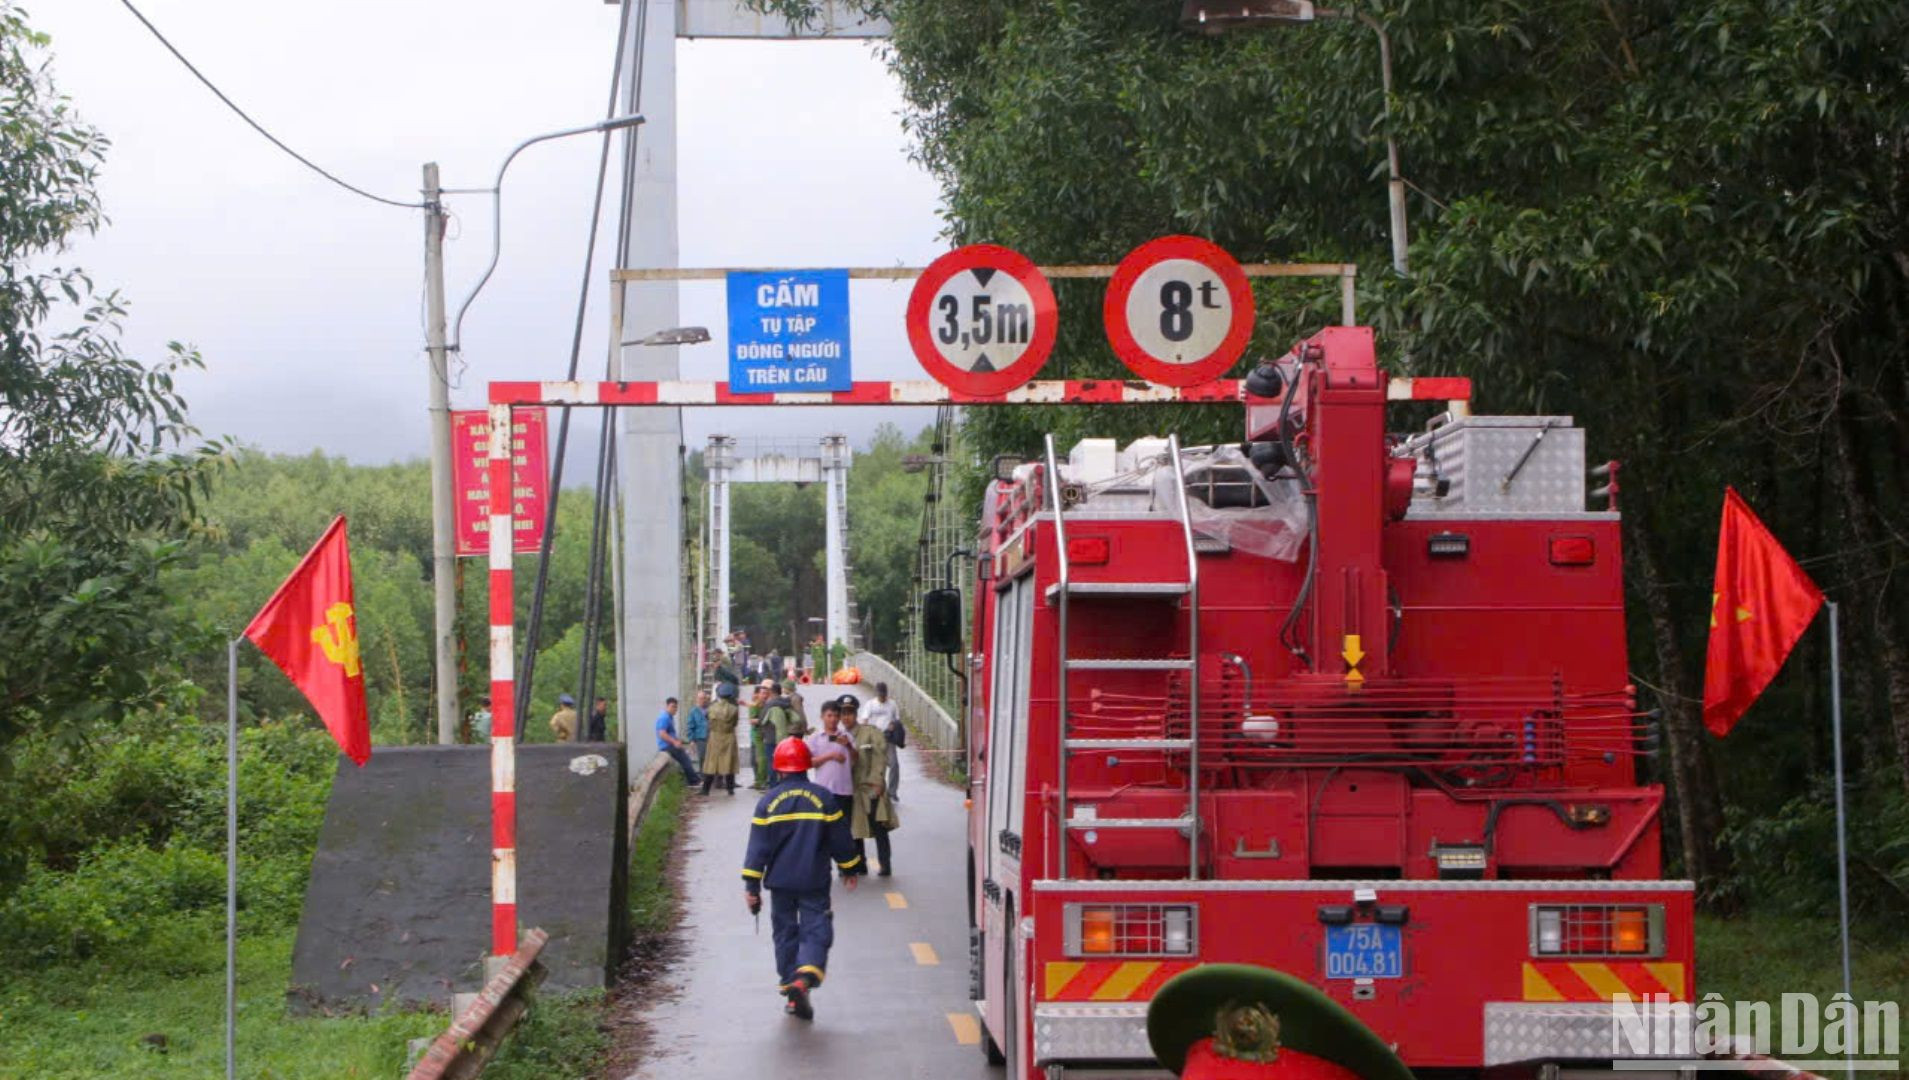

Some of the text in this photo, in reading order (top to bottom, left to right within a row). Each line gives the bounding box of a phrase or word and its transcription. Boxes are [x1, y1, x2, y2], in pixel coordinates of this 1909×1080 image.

[757, 277, 819, 308] CẤM
[938, 296, 1028, 350] 3,5m
[1160, 281, 1193, 341] 8
[761, 314, 817, 336] TỤ TẬP
[747, 365, 790, 384] TRÊN
[1345, 927, 1383, 950] 75A
[1329, 952, 1398, 976] 004.81
